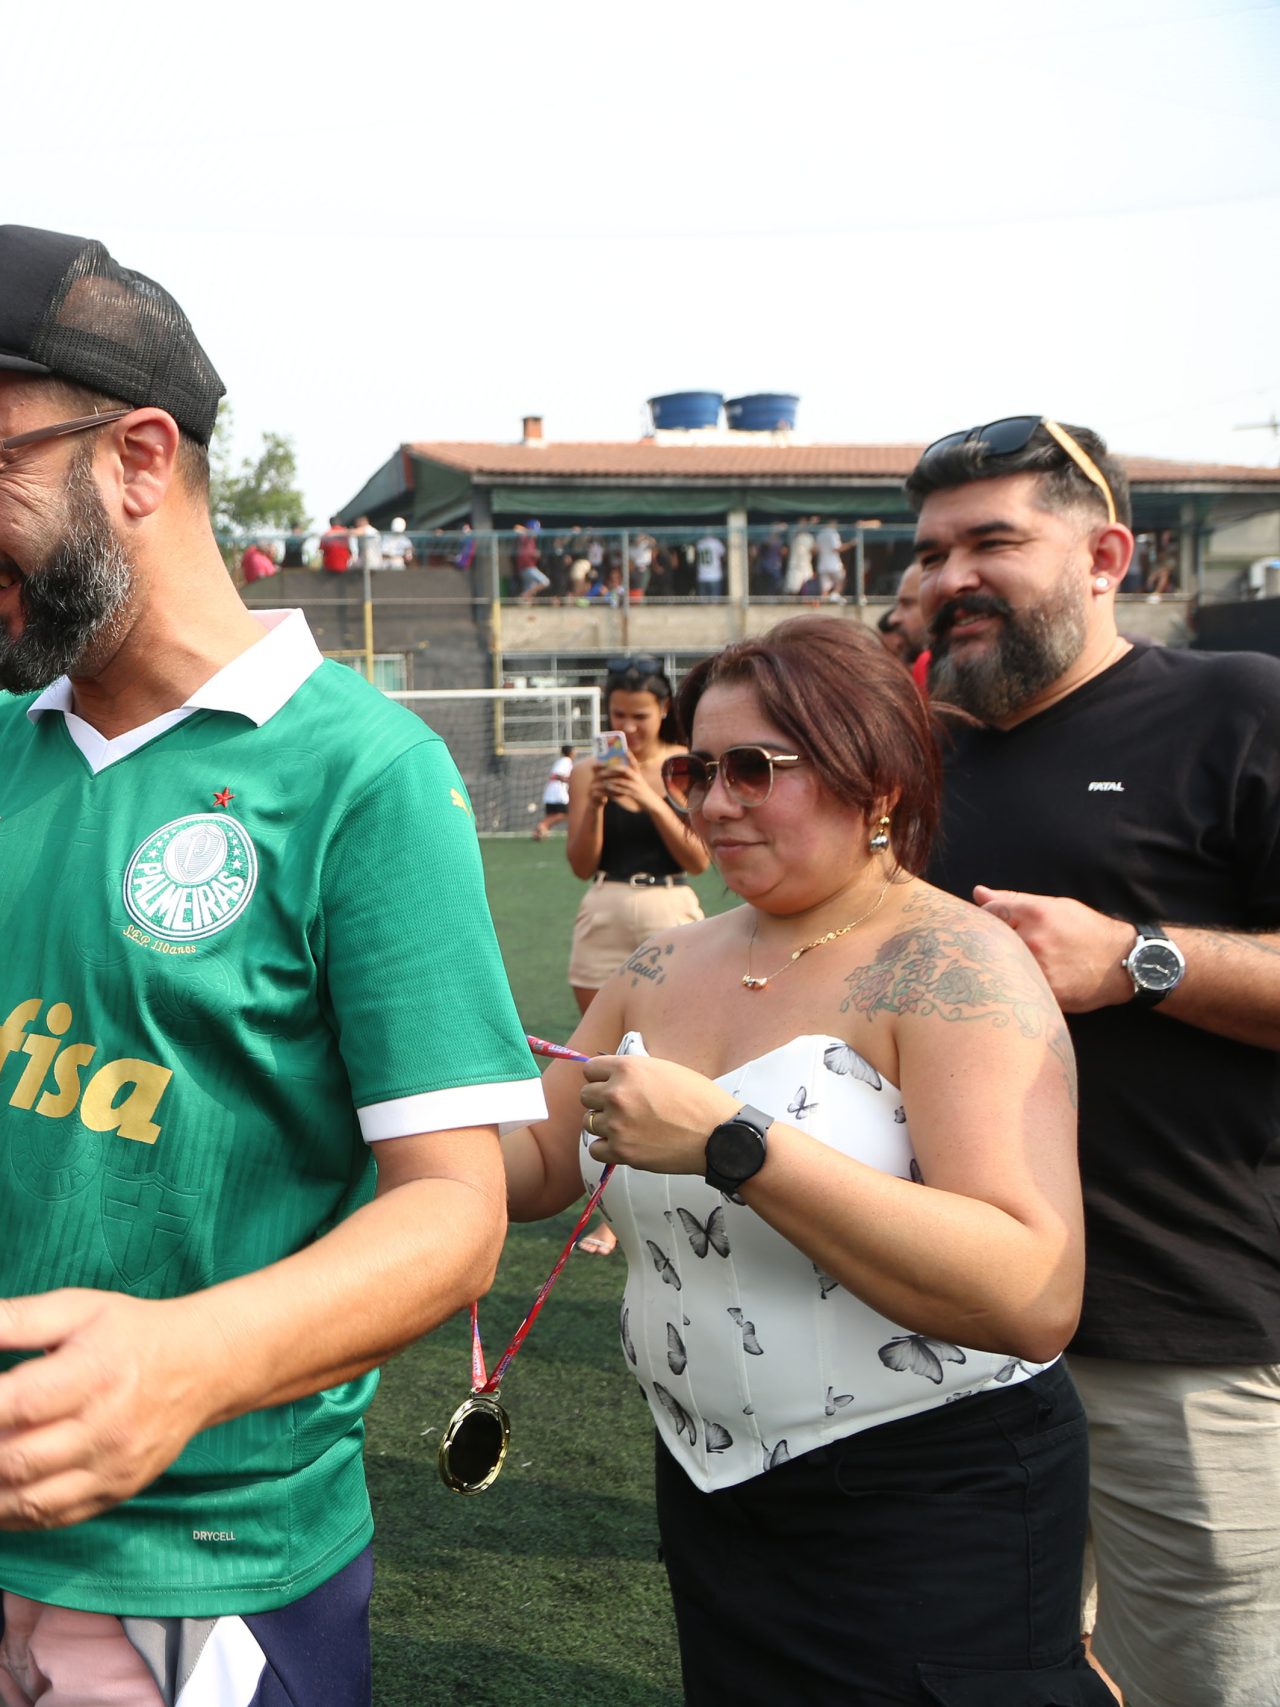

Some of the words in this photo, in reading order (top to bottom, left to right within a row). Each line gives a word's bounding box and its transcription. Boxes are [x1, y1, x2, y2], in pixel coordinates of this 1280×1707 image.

[1087, 781, 1125, 792] FATAL
[133, 861, 245, 931] PALMEIRAS
[192, 1530, 236, 1541] DRYCELL
